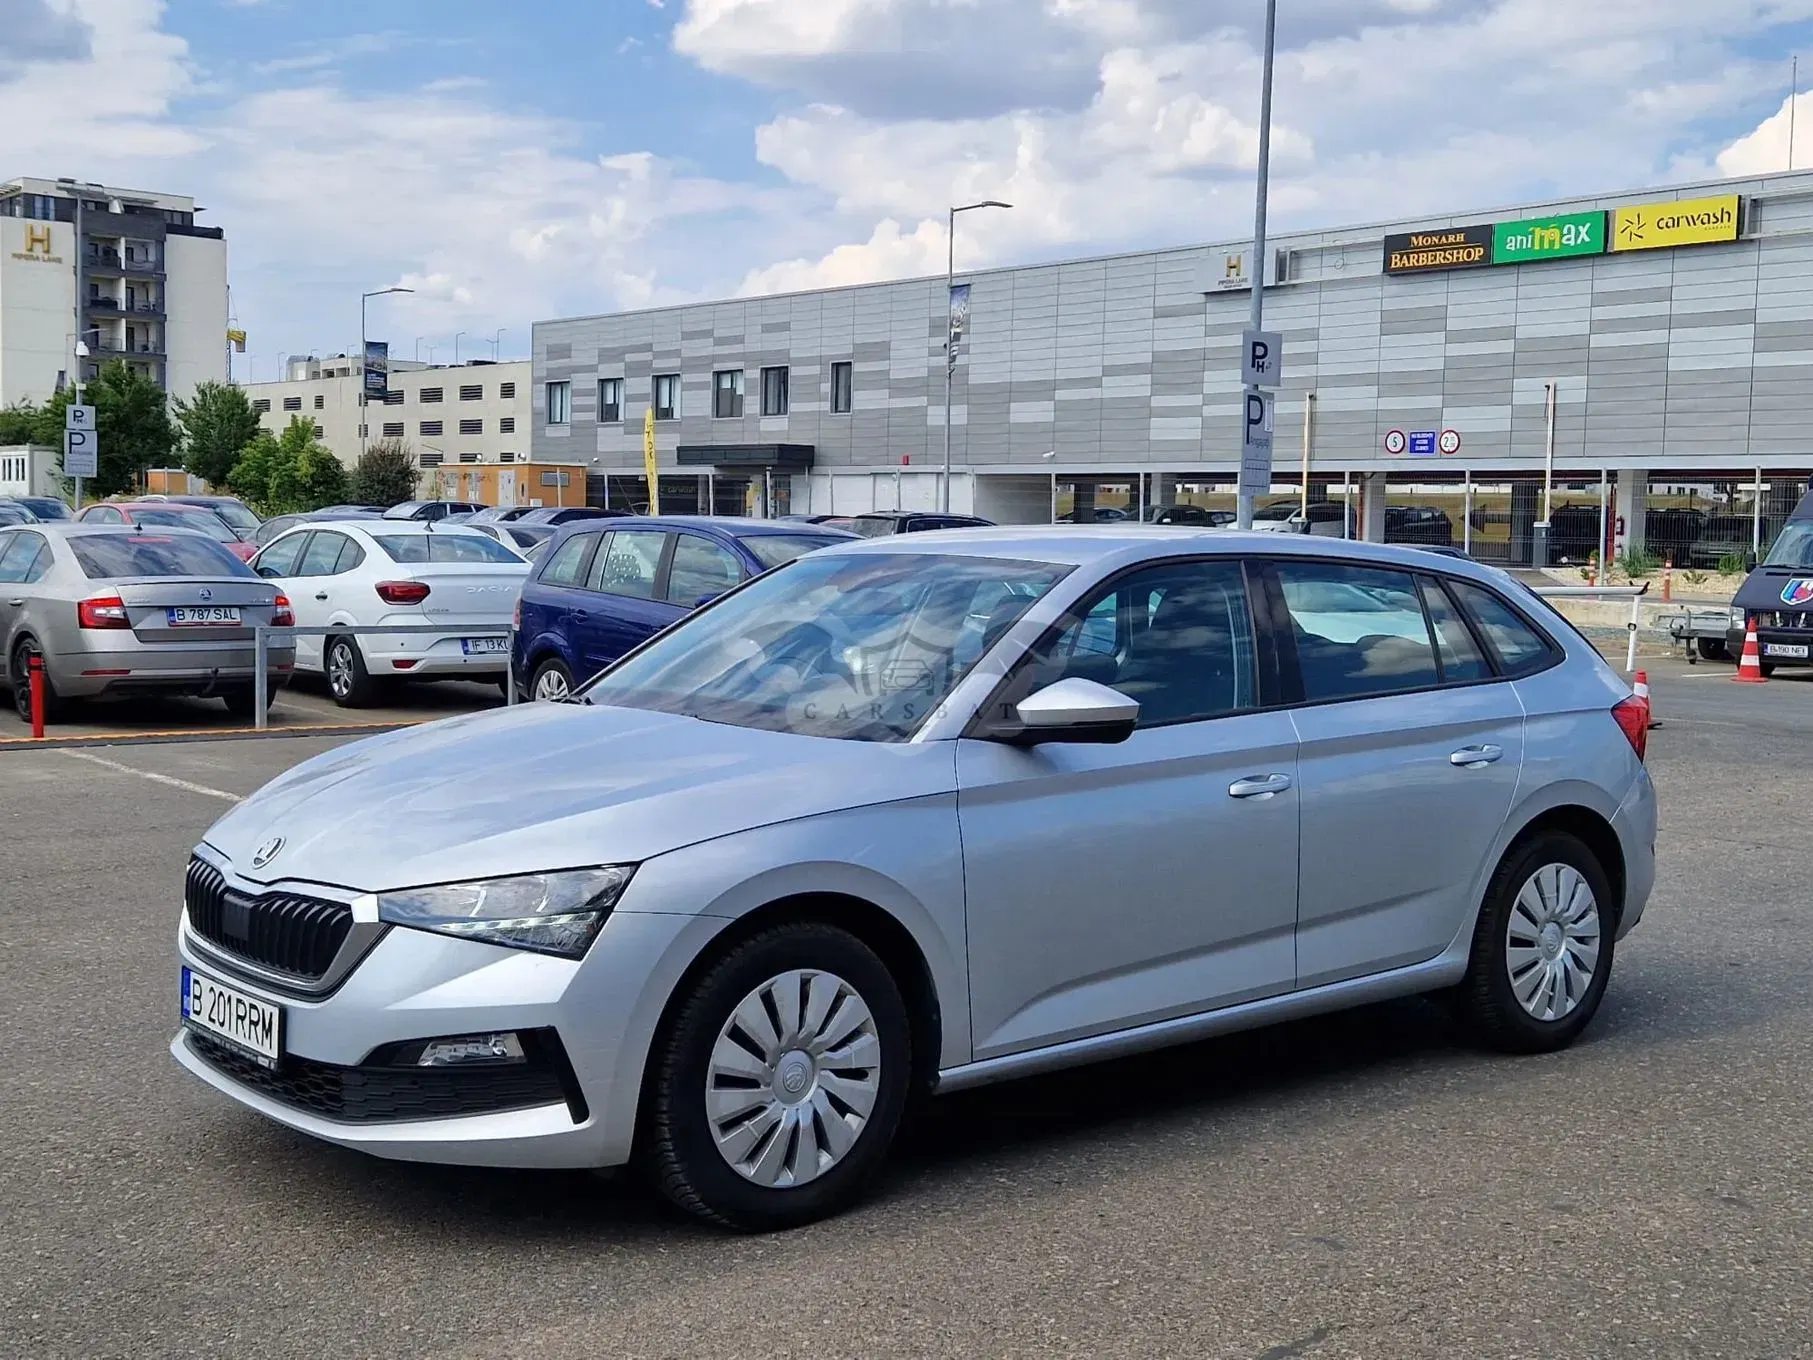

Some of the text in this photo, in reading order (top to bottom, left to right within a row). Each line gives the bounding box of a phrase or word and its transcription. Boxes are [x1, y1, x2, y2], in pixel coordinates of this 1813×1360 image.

[1657, 208, 1731, 230] carwash
[1391, 247, 1484, 269] BARBERSHOP
[176, 609, 237, 621] B 787 SAL
[193, 978, 203, 1016] B
